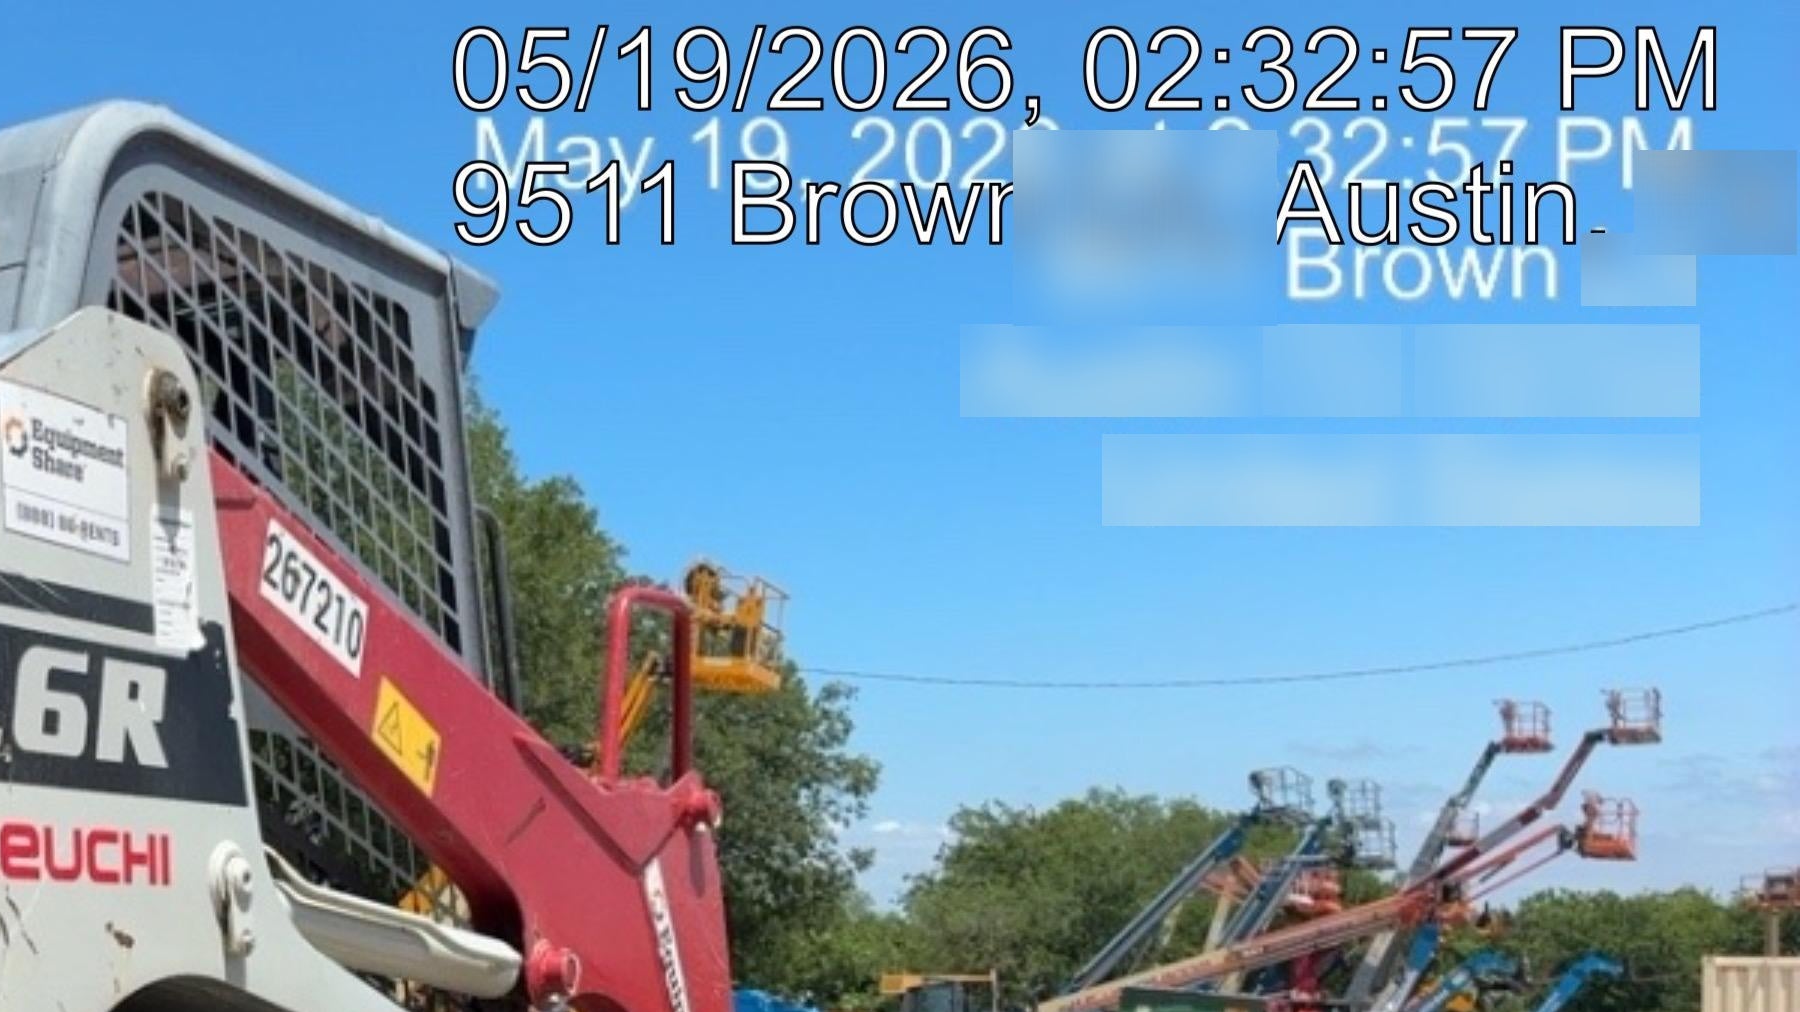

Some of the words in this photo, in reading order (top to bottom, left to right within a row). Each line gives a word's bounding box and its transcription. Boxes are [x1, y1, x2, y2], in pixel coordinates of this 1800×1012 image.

[30, 417, 125, 470] Equipment
[31, 446, 85, 483] Share
[262, 533, 366, 660] 267210
